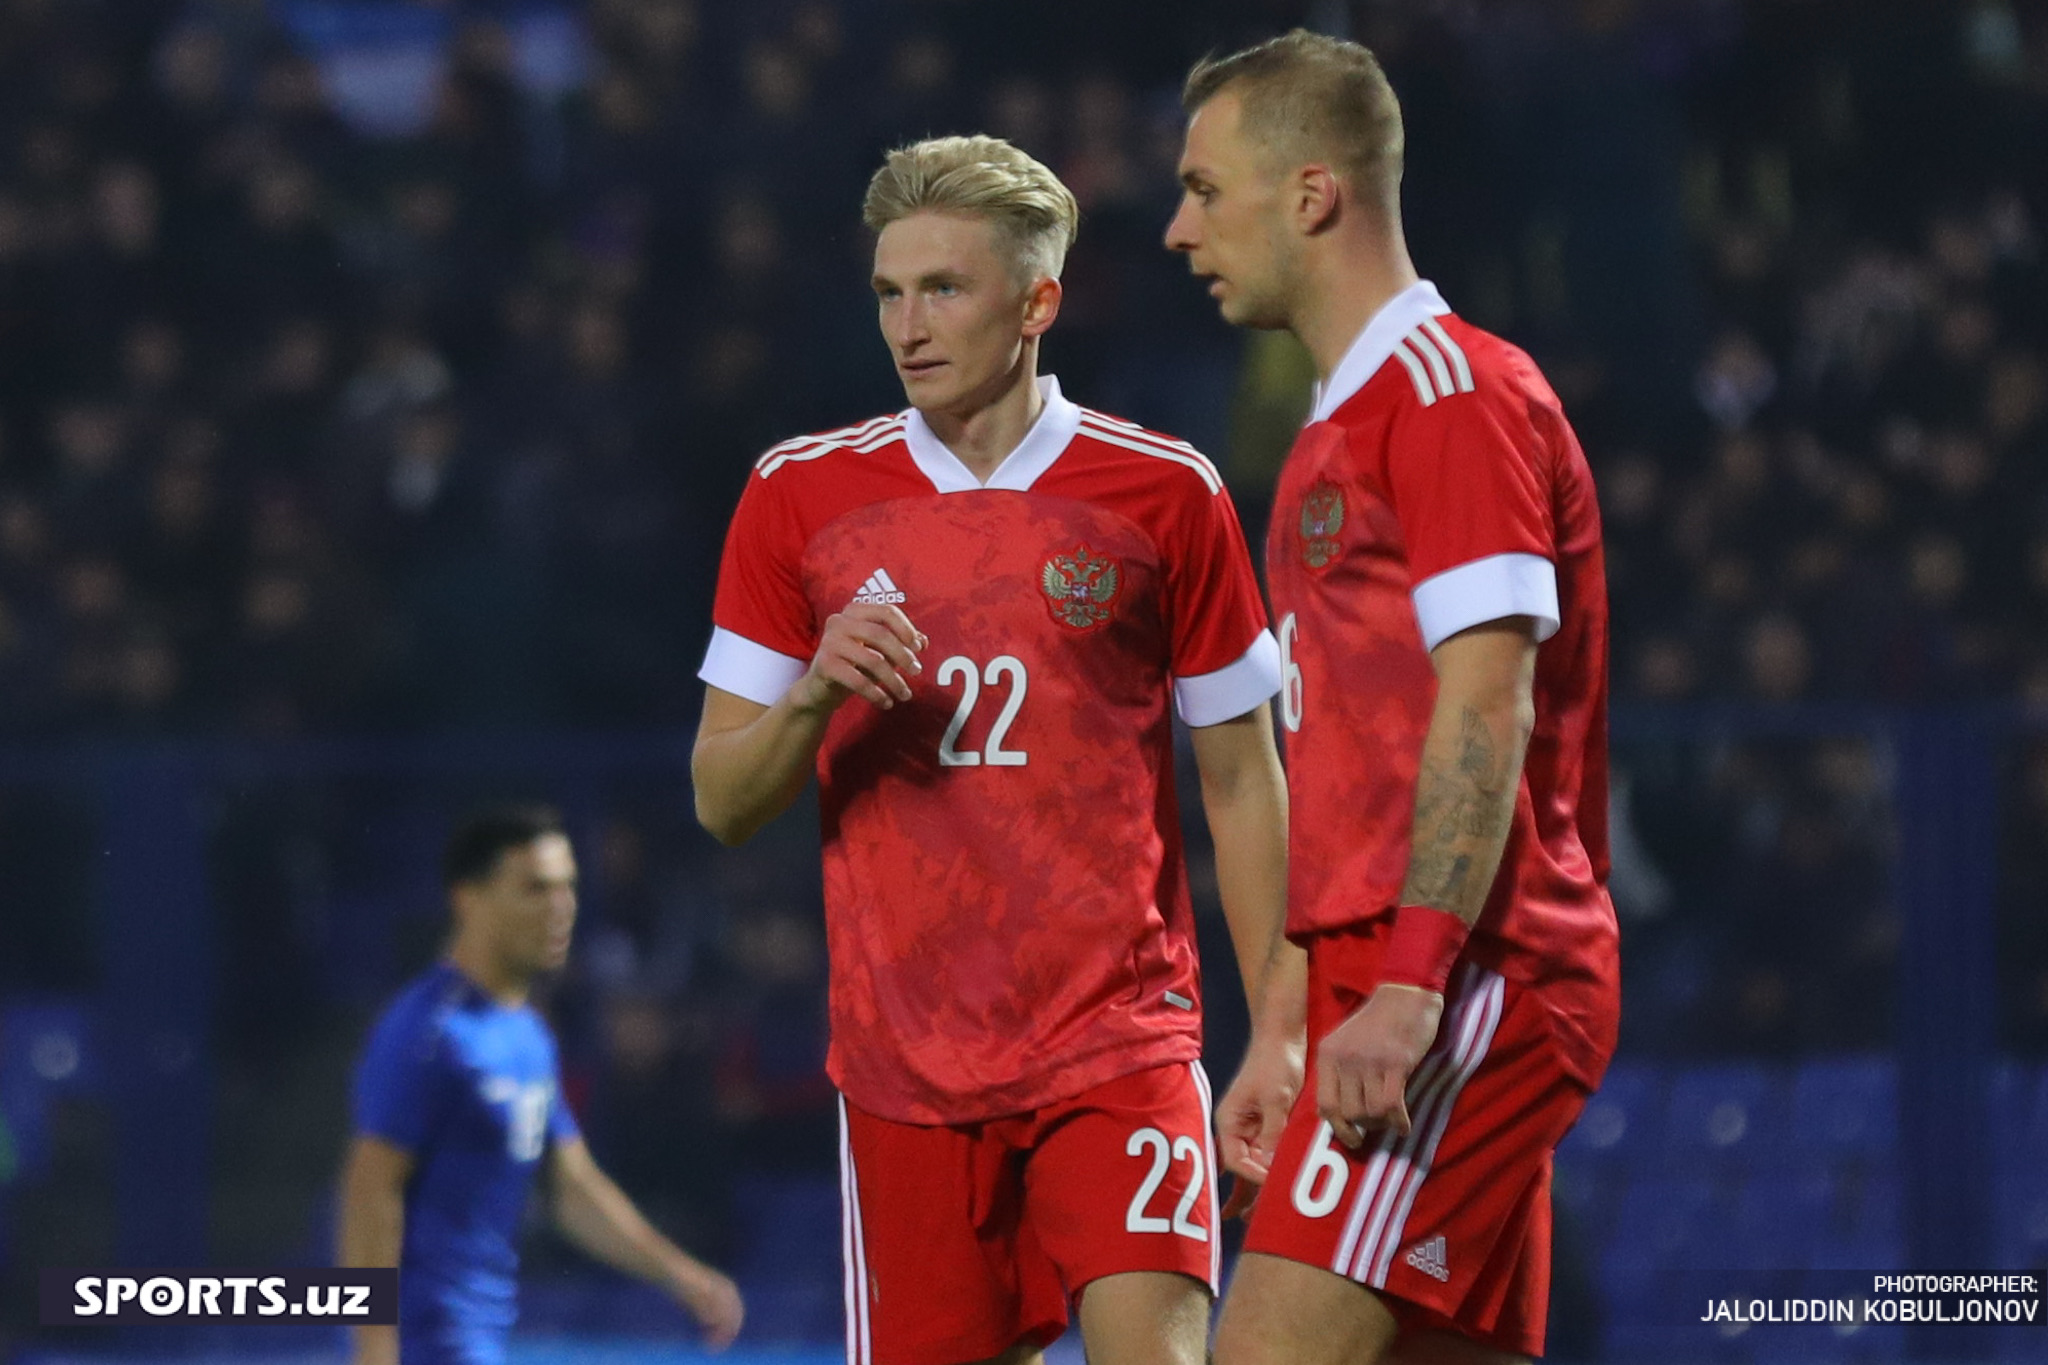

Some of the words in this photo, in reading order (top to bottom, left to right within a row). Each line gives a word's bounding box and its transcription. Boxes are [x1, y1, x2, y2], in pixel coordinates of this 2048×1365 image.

[852, 591, 906, 605] adidas
[937, 655, 1028, 767] 22
[1280, 612, 1303, 732] 6
[1126, 1127, 1208, 1242] 22
[1292, 1119, 1350, 1218] 6
[1406, 1253, 1450, 1282] adidas
